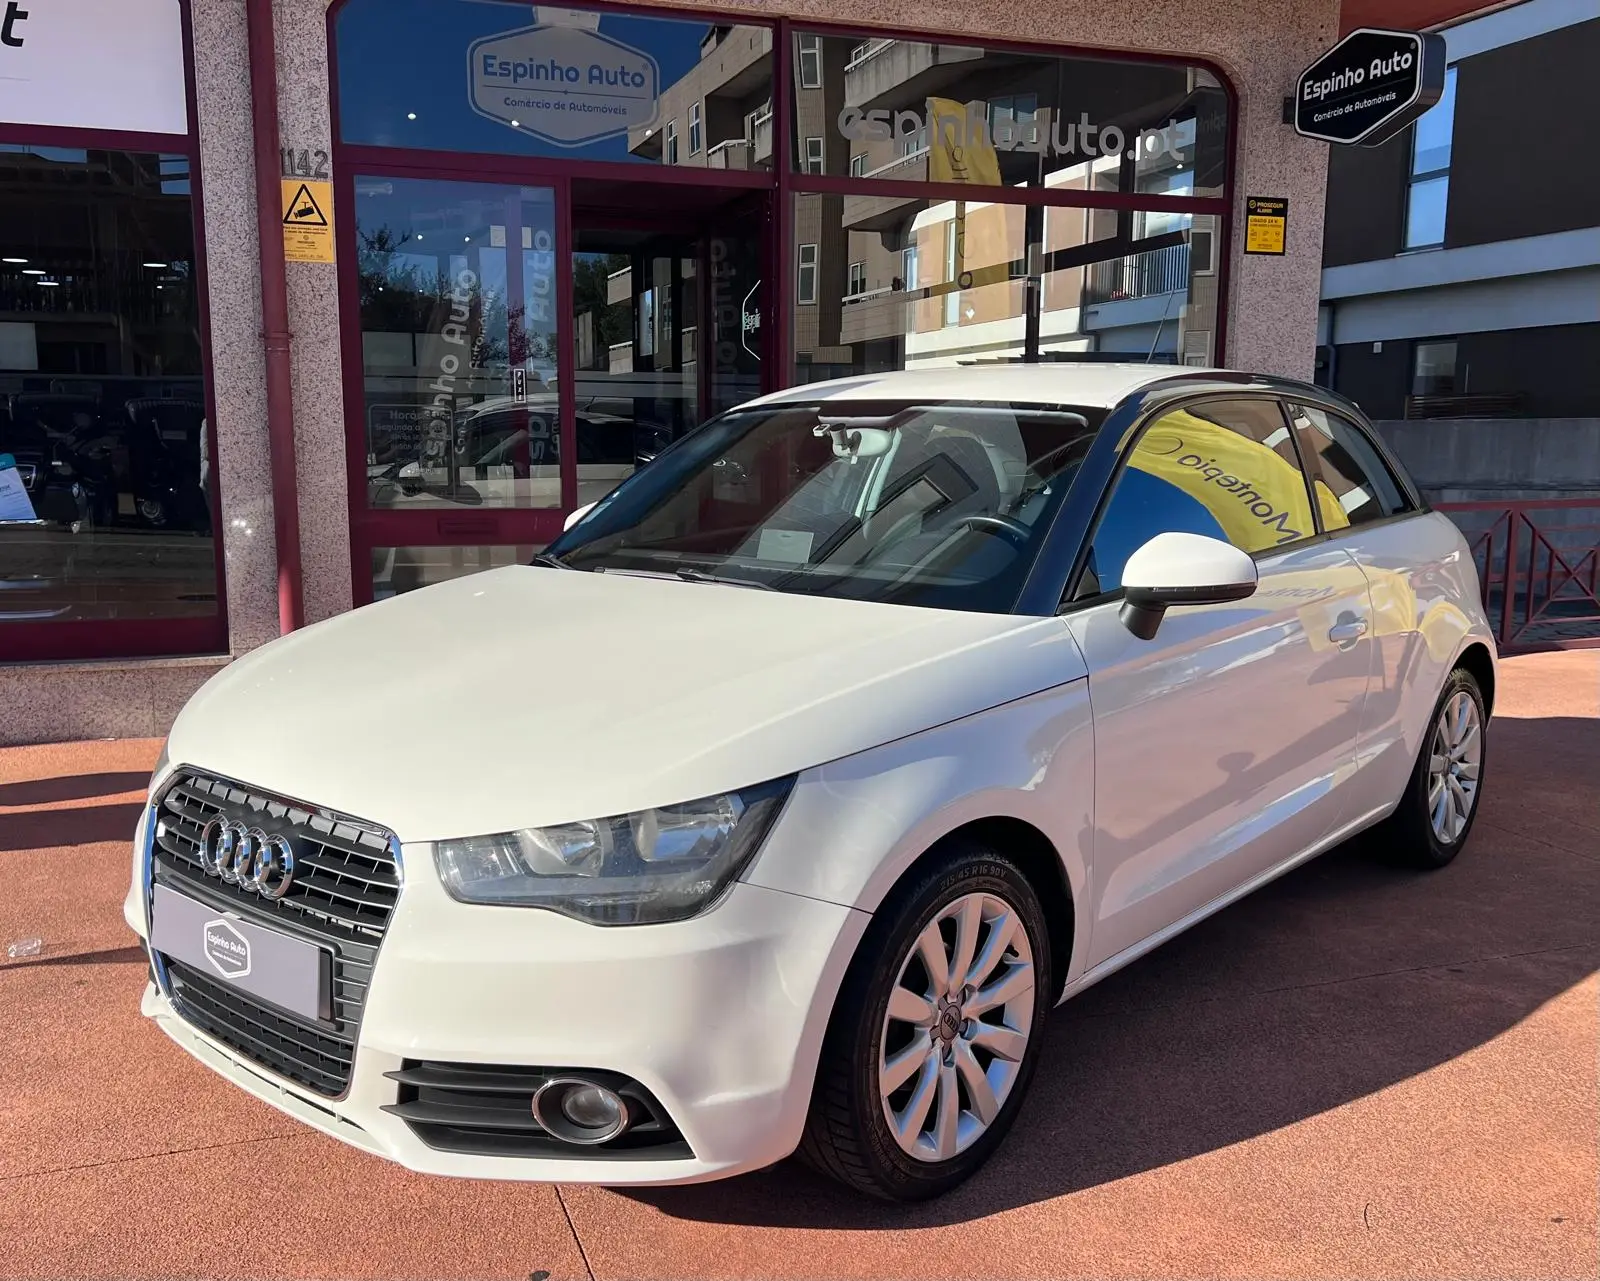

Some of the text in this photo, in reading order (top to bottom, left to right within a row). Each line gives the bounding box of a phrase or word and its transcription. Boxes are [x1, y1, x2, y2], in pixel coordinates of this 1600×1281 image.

[483, 54, 645, 88] Espinho Auto
[1303, 50, 1413, 101] Espinho Auto
[503, 97, 627, 116] Comércio de Automóveis
[1313, 91, 1397, 123] Comércio de Automóveis
[837, 101, 1186, 162] espinhoauto.pt
[440, 269, 477, 345] Auto
[208, 931, 246, 956] Espinho Auto
